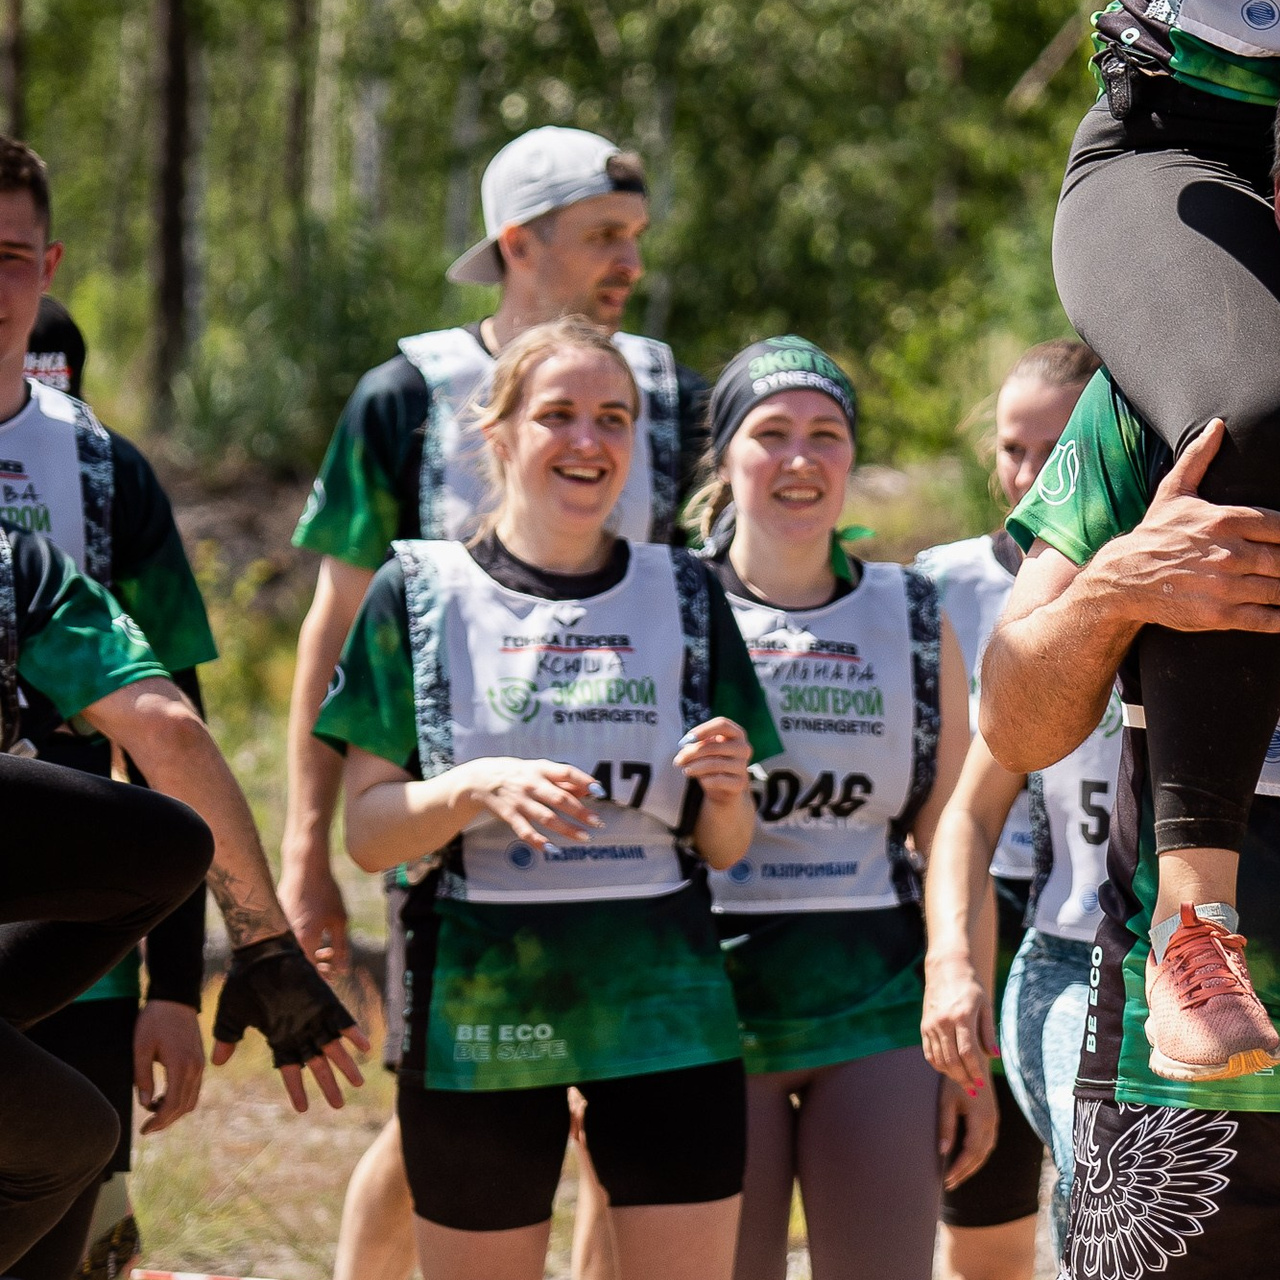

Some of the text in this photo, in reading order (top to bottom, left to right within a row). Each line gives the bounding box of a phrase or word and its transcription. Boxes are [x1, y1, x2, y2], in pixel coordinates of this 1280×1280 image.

[780, 684, 885, 717] ЭКОГЕРОЙ
[552, 708, 659, 725] SYNERGETIC
[780, 716, 885, 736] SYNERGETIC
[752, 768, 874, 822] 046
[1086, 945, 1103, 1054] BE ECO
[456, 1023, 554, 1041] BE ECO
[453, 1039, 568, 1062] BE SAFE
